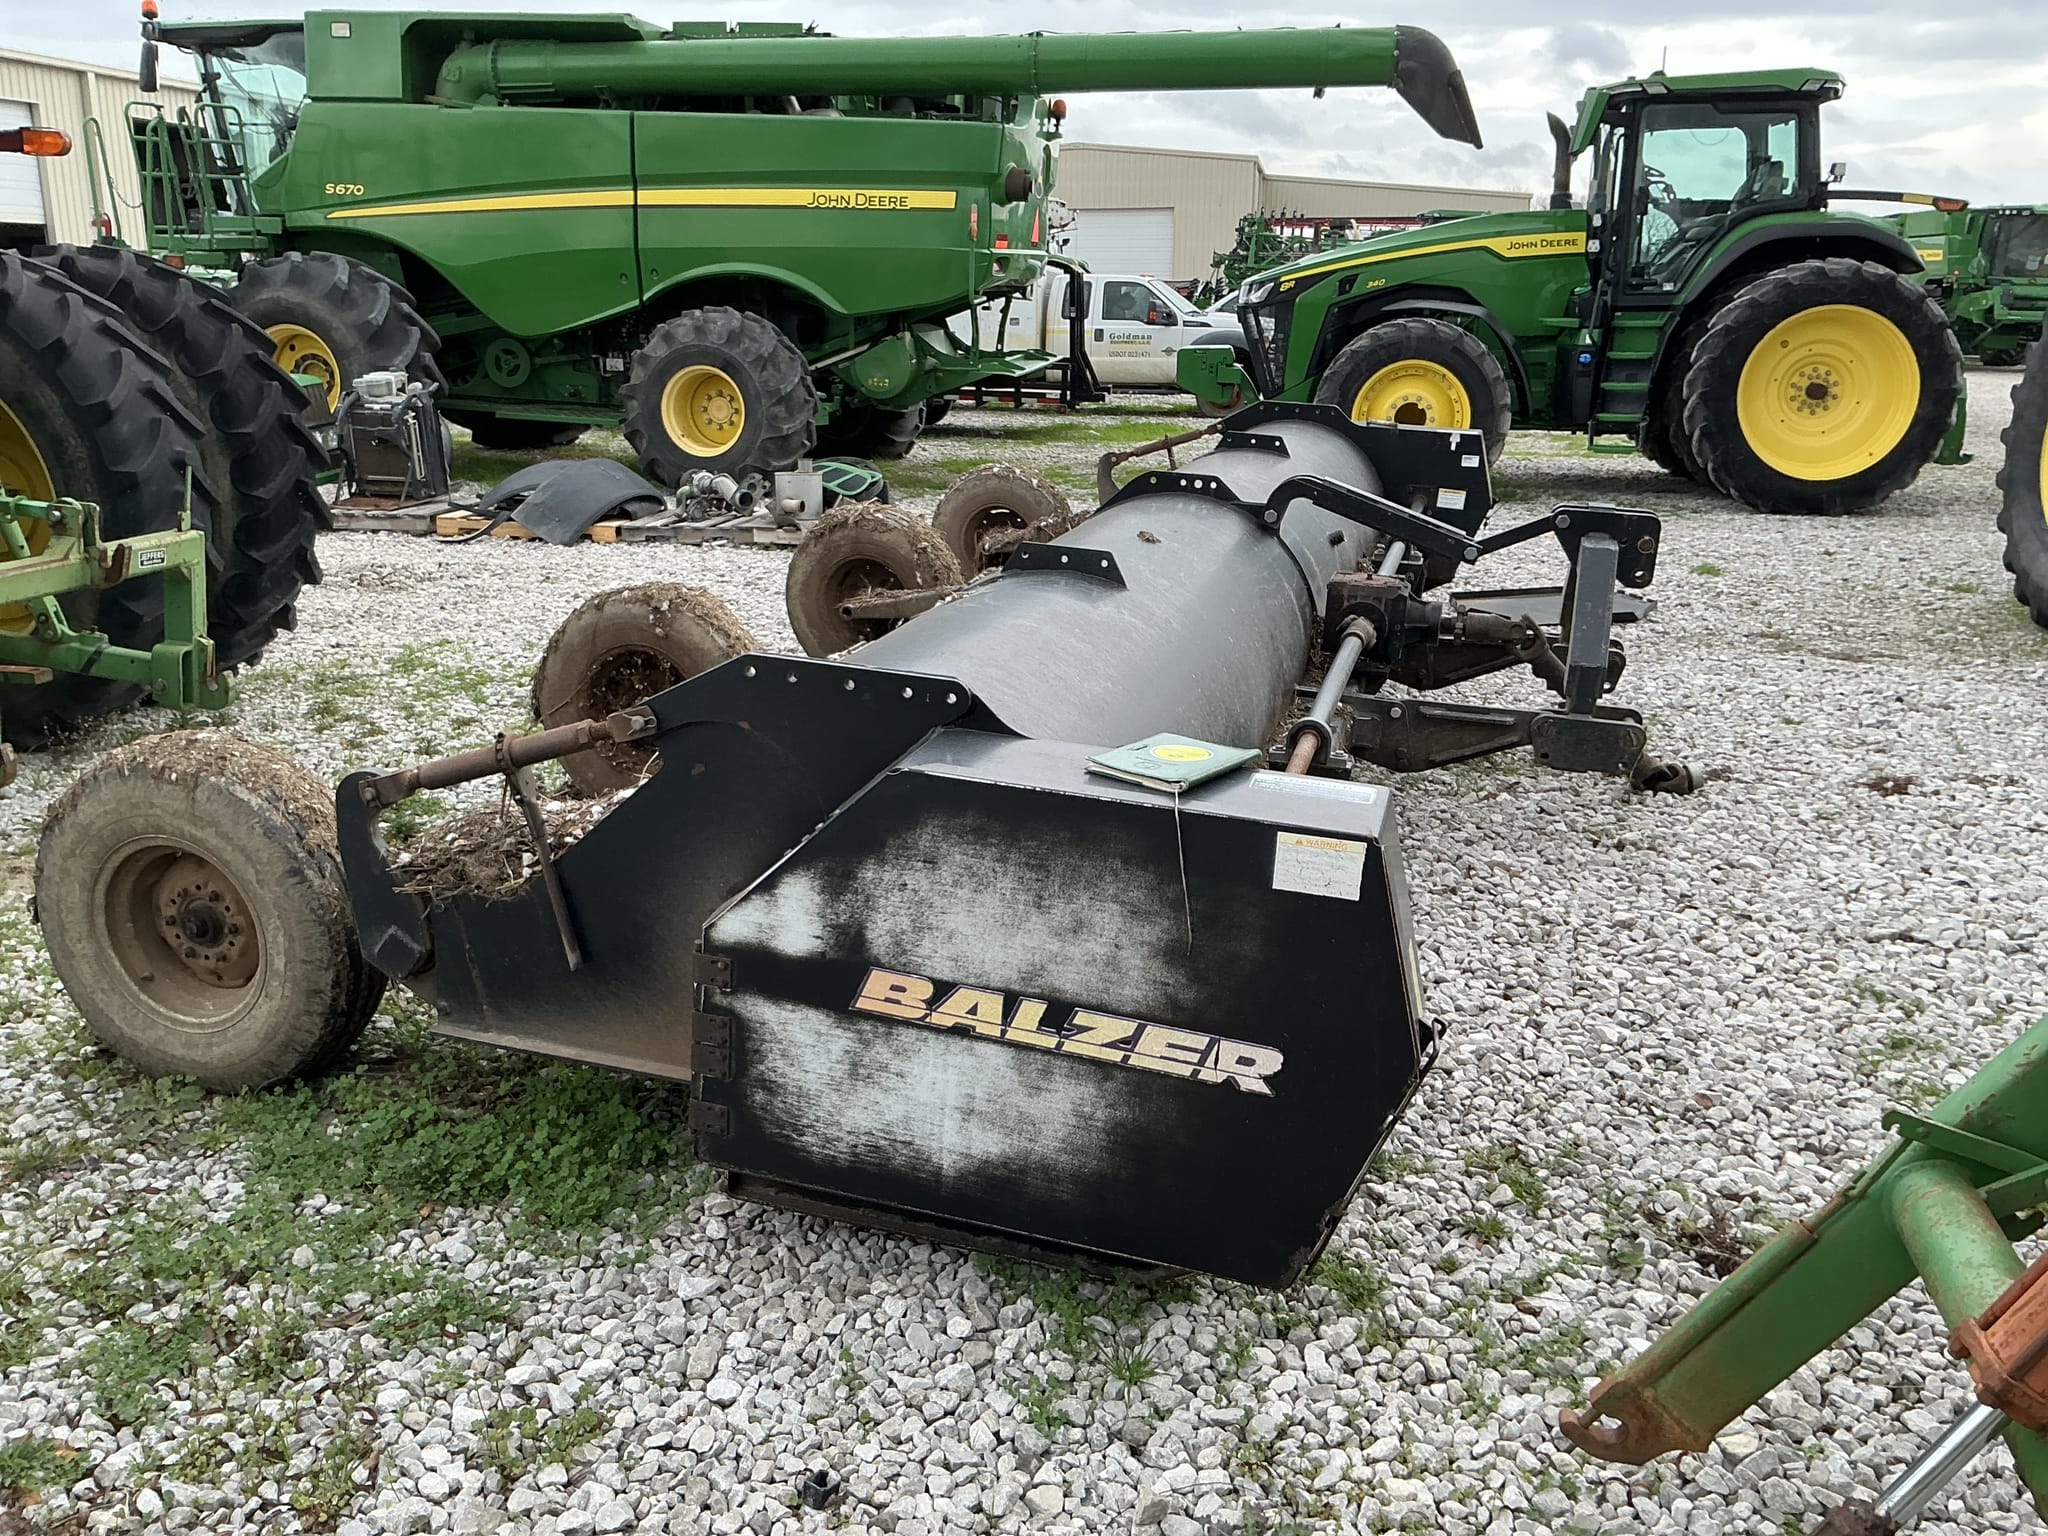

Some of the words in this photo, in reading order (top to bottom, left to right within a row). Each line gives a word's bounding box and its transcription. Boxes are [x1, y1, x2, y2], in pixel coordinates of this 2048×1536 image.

[325, 183, 364, 195] S670
[807, 192, 851, 206] JOHN
[855, 193, 909, 207] DEERE
[1507, 240, 1538, 250] JOHN
[1540, 238, 1579, 248] DEERE
[1366, 279, 1386, 288] 340
[1305, 839, 1347, 851] WARNING
[850, 966, 1284, 1097] BALZER
